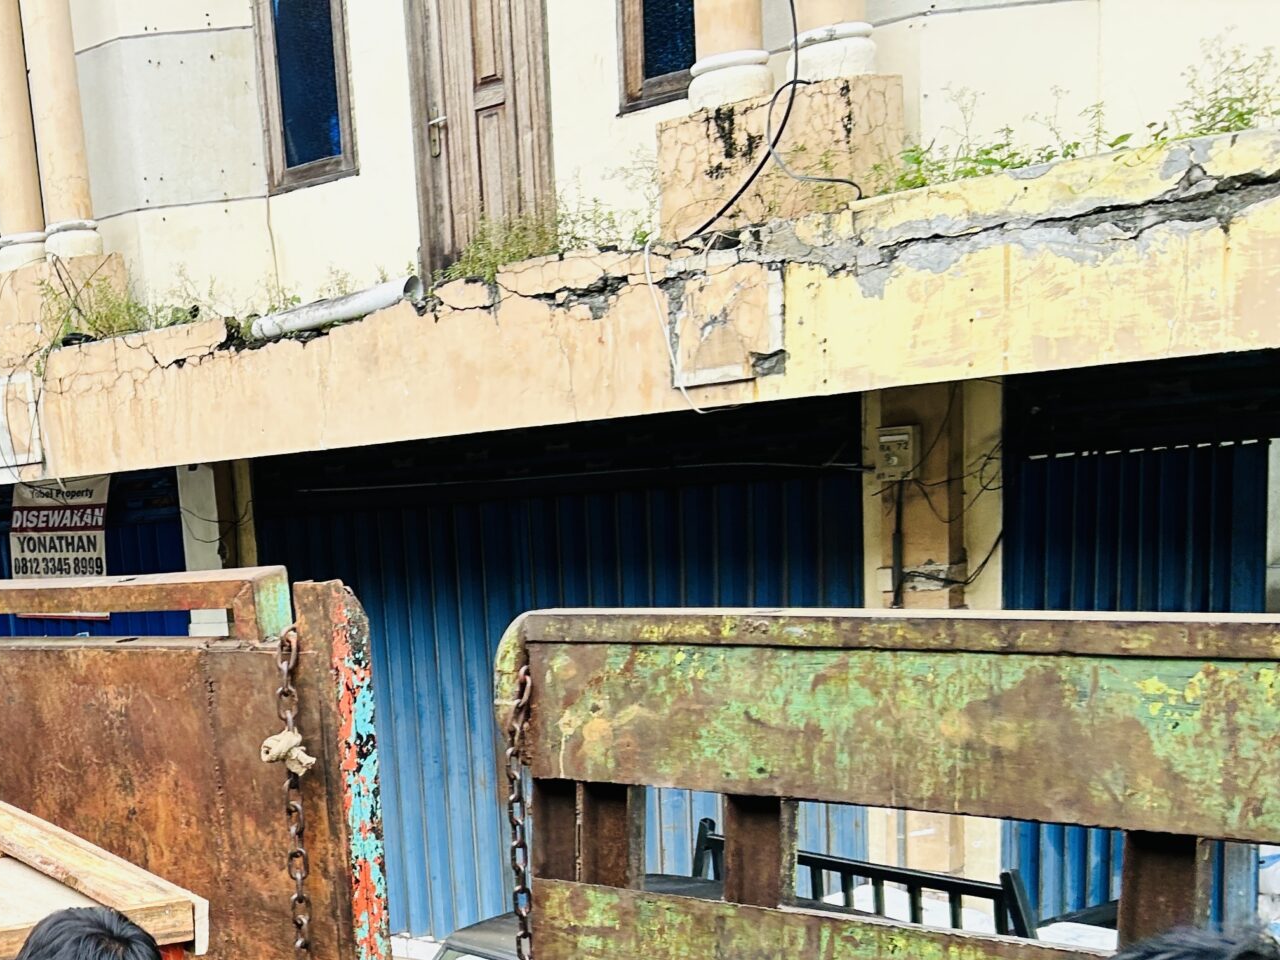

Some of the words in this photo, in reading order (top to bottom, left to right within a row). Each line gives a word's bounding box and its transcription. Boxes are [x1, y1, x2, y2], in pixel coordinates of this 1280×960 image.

[55, 488, 94, 499] Property
[11, 508, 105, 528] DISEWAKAN
[17, 535, 97, 553] YONATHAN
[14, 557, 40, 575] 0812
[41, 557, 71, 575] 3345
[73, 556, 104, 575] 8999
